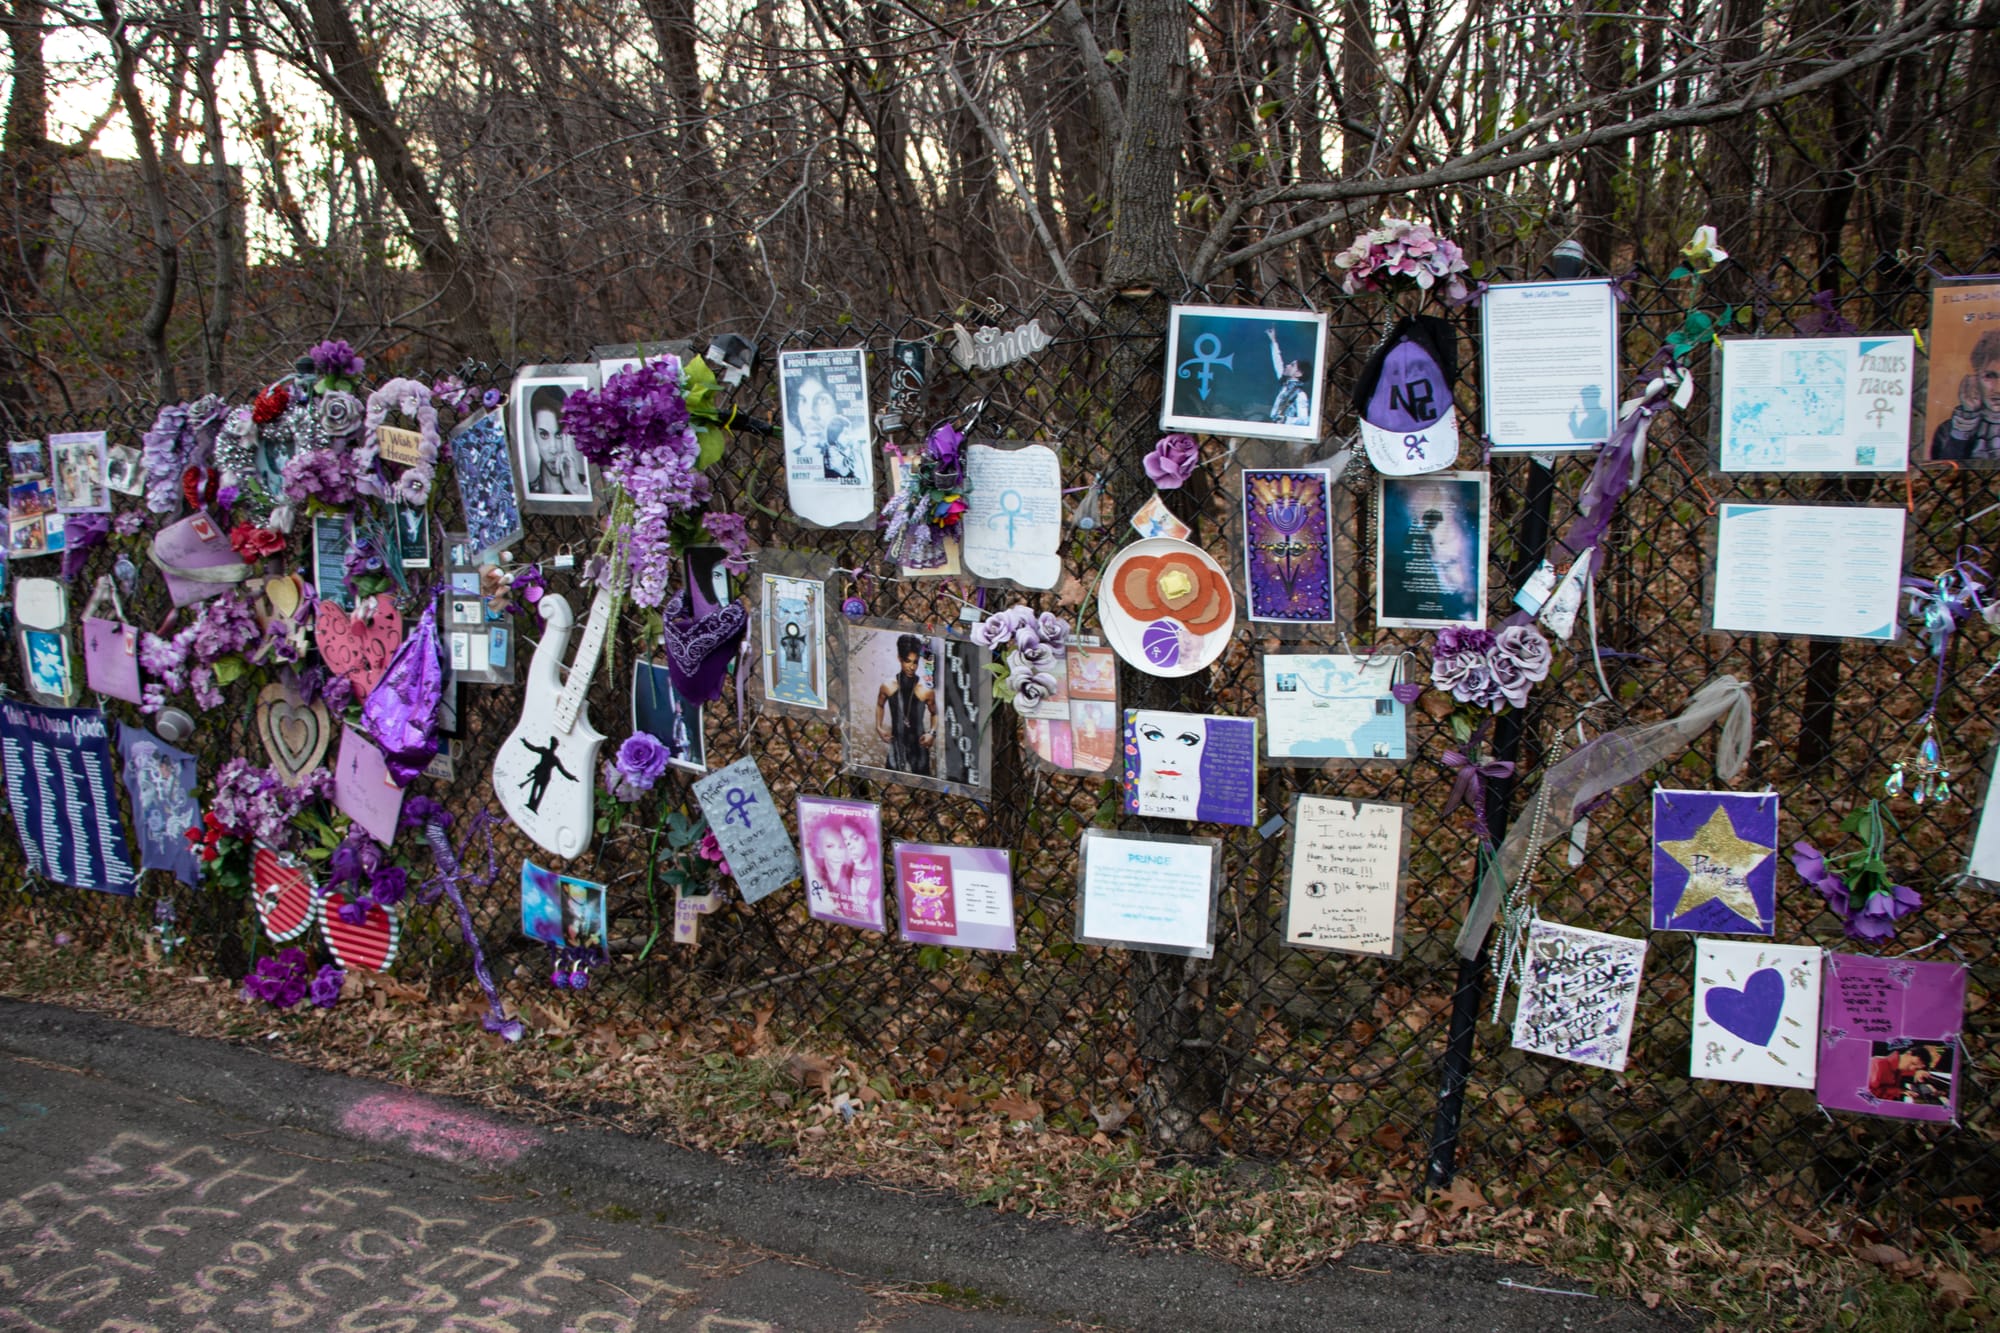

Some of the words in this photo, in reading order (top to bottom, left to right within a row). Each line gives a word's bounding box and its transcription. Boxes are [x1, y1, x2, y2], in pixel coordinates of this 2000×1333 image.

[951, 322, 1047, 372] Prince
[390, 430, 414, 449] Wish
[945, 641, 979, 723] TRULY
[945, 705, 979, 785] ADORE
[1317, 823, 1333, 838] I
[1128, 852, 1173, 866] PRINCE
[1690, 853, 1733, 877] Prince
